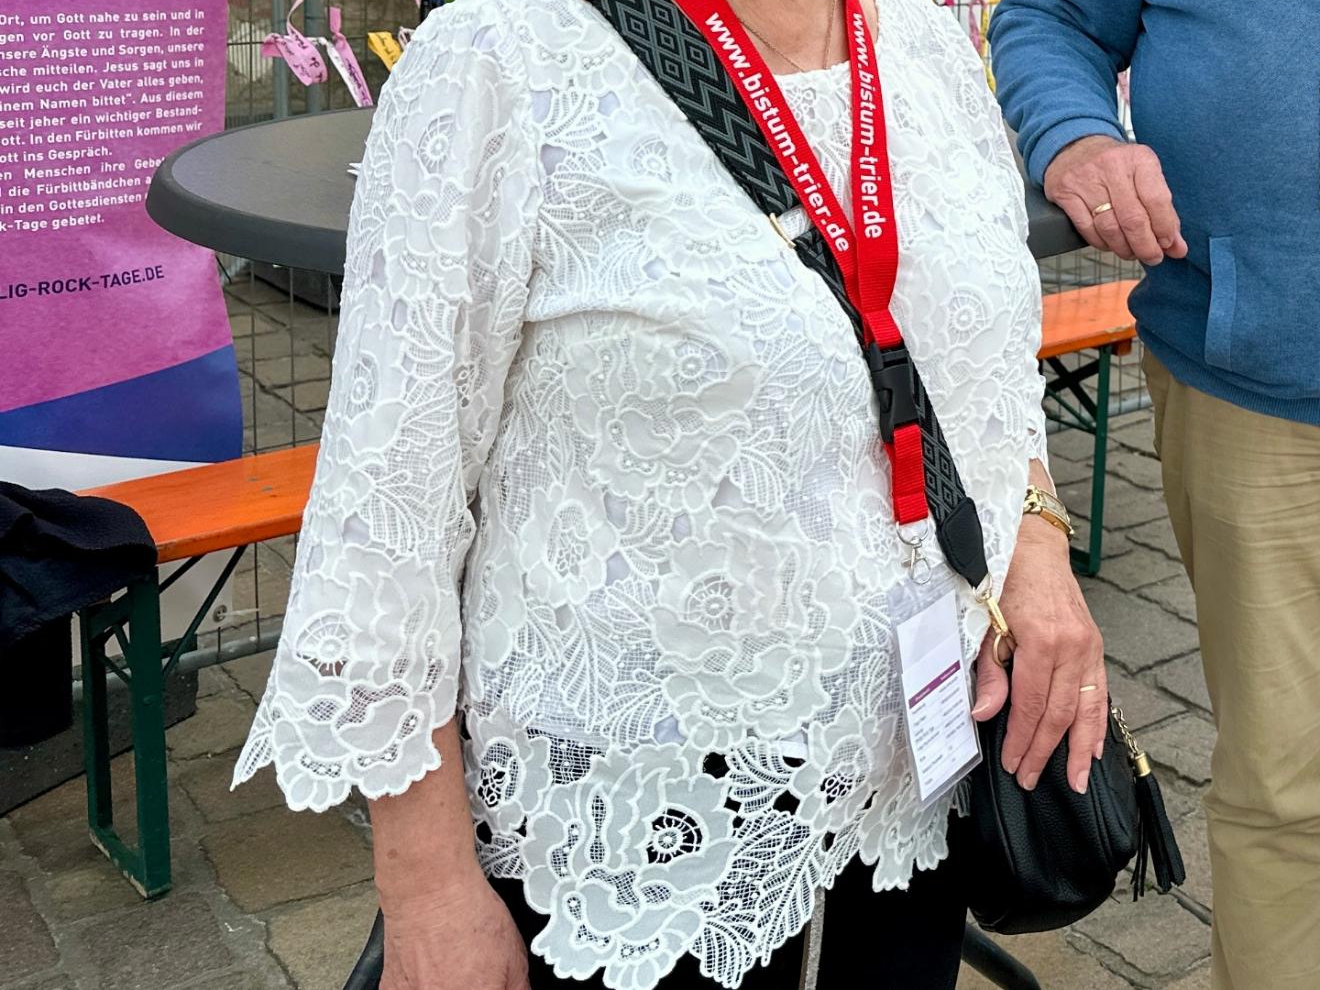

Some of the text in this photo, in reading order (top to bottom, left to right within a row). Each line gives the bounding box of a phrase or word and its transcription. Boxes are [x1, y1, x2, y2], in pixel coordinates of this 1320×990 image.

[0, 9, 205, 26] Ort, um Gott nahe zu sein und in
[0, 25, 205, 45] gen vor Gott zu tragen. In der
[41, 44, 88, 60] Ängste
[92, 46, 115, 56] und
[118, 44, 164, 57] Sorgen,
[167, 42, 205, 53] unsere
[0, 56, 204, 77] che mitteilen. Jesus sagt uns in
[0, 73, 204, 94] wird euch der Vater alles geben,
[40, 98, 87, 110] Namen
[140, 93, 162, 104] Aus
[165, 90, 203, 101] diesem
[0, 105, 203, 130] seit jeher ein wichtiger Bestand-
[852, 12, 886, 239] www.bistum-trier.de
[30, 133, 43, 145] In
[47, 132, 71, 144] den
[75, 128, 134, 142] Fürbitten
[136, 124, 184, 137] kommen
[186, 121, 203, 132] wir
[704, 11, 850, 253] www.bistum-trier.de
[0, 146, 113, 164] ott ins Gespräch.
[24, 164, 91, 179] Menschen
[100, 161, 126, 173] ihre
[134, 156, 165, 170] Gebe
[8, 185, 30, 197] die
[36, 176, 141, 195] Fürbittbändchen
[18, 202, 44, 214] den
[49, 192, 142, 211] Gottesdiensten
[52, 212, 105, 230] gebetet.
